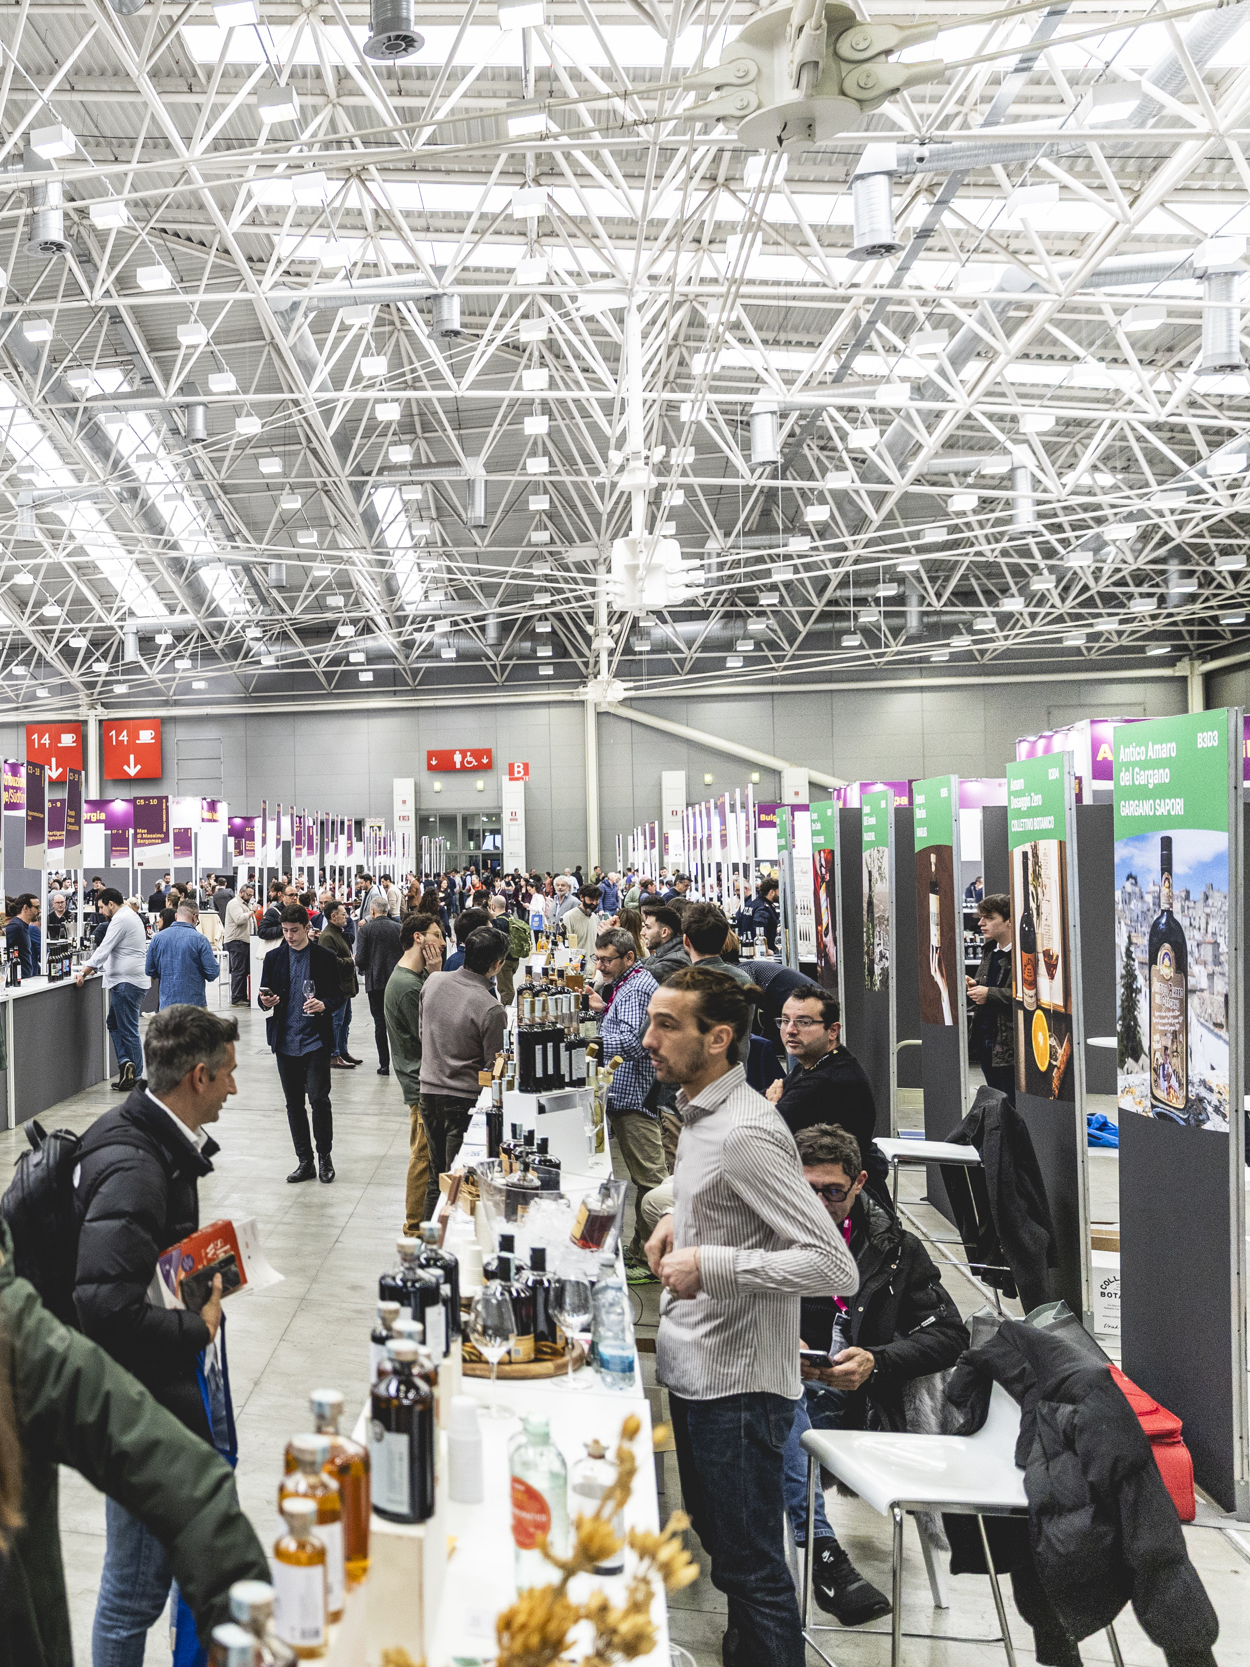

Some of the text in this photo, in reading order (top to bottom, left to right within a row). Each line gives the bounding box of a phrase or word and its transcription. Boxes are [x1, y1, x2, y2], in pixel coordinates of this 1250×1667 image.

[31, 733, 51, 748] 14
[109, 729, 128, 745] 14
[1197, 730, 1218, 748] B3D3
[1119, 744, 1146, 762] Antico
[1147, 741, 1176, 760] Amaro
[514, 763, 524, 777] B
[1119, 766, 1170, 788] del Gargano
[1120, 798, 1184, 816] GARGANO SAPORI
[83, 810, 106, 822] orgia
[1100, 1275, 1120, 1290] COLL
